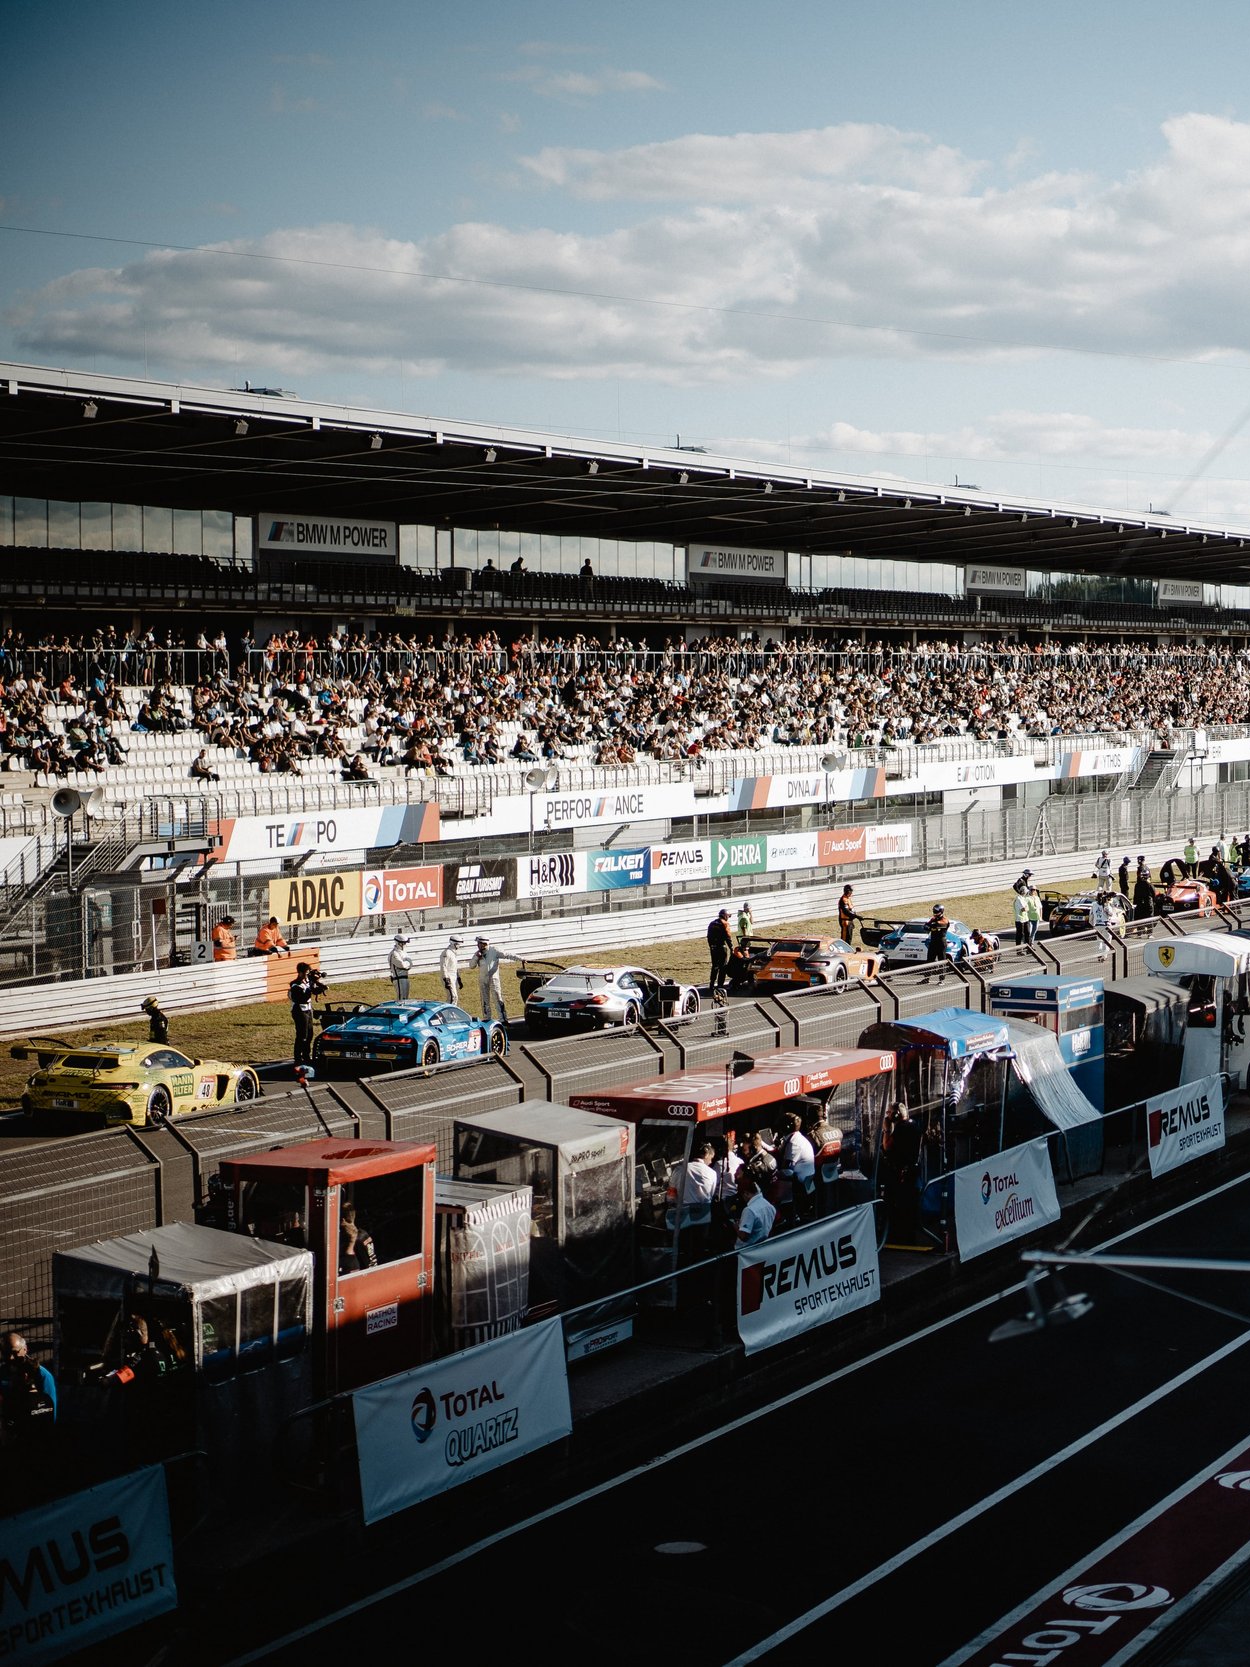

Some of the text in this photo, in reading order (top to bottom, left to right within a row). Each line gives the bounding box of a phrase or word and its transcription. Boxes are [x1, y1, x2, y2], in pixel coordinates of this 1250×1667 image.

[296, 523, 328, 545] BMW
[329, 525, 341, 546] M
[343, 526, 387, 548] POWER
[718, 555, 774, 572] BMW M POWER
[1002, 573, 1021, 587] POWER
[957, 763, 995, 783] EOTION
[787, 777, 835, 799] DYNAK
[547, 794, 644, 821] PERFORANCE
[731, 843, 761, 866] DEKRA
[832, 840, 844, 852] Audi
[594, 854, 644, 873] FALKEN
[661, 849, 703, 866] REMUS
[530, 855, 557, 886] H&R
[385, 879, 436, 902] TOTAL
[456, 877, 502, 893] GRAN TURISMO
[287, 876, 344, 922] ADAC
[197, 944, 206, 958] 2
[171, 1074, 193, 1085] MANN
[173, 1084, 193, 1096] FILTER
[201, 1083, 210, 1098] 48
[594, 1101, 610, 1109] Sport
[706, 1097, 727, 1109] Audi Sport
[718, 1105, 731, 1114] Phoenx
[1160, 1094, 1211, 1137] REMUS
[1179, 1122, 1222, 1151] SPORTEXHAUST
[993, 1172, 1019, 1194] TOTAL
[995, 1194, 1035, 1231] excellium
[761, 1234, 858, 1299] REMUS
[795, 1268, 876, 1317] SPORTEXHAUST
[367, 1306, 396, 1321] MATHOL
[368, 1317, 396, 1331] RACING
[440, 1380, 505, 1421] TOTAL
[444, 1407, 519, 1468] QUARTZ
[0, 1563, 167, 1655] SPORTEXHAUST
[988, 1615, 1122, 1667] TOT
